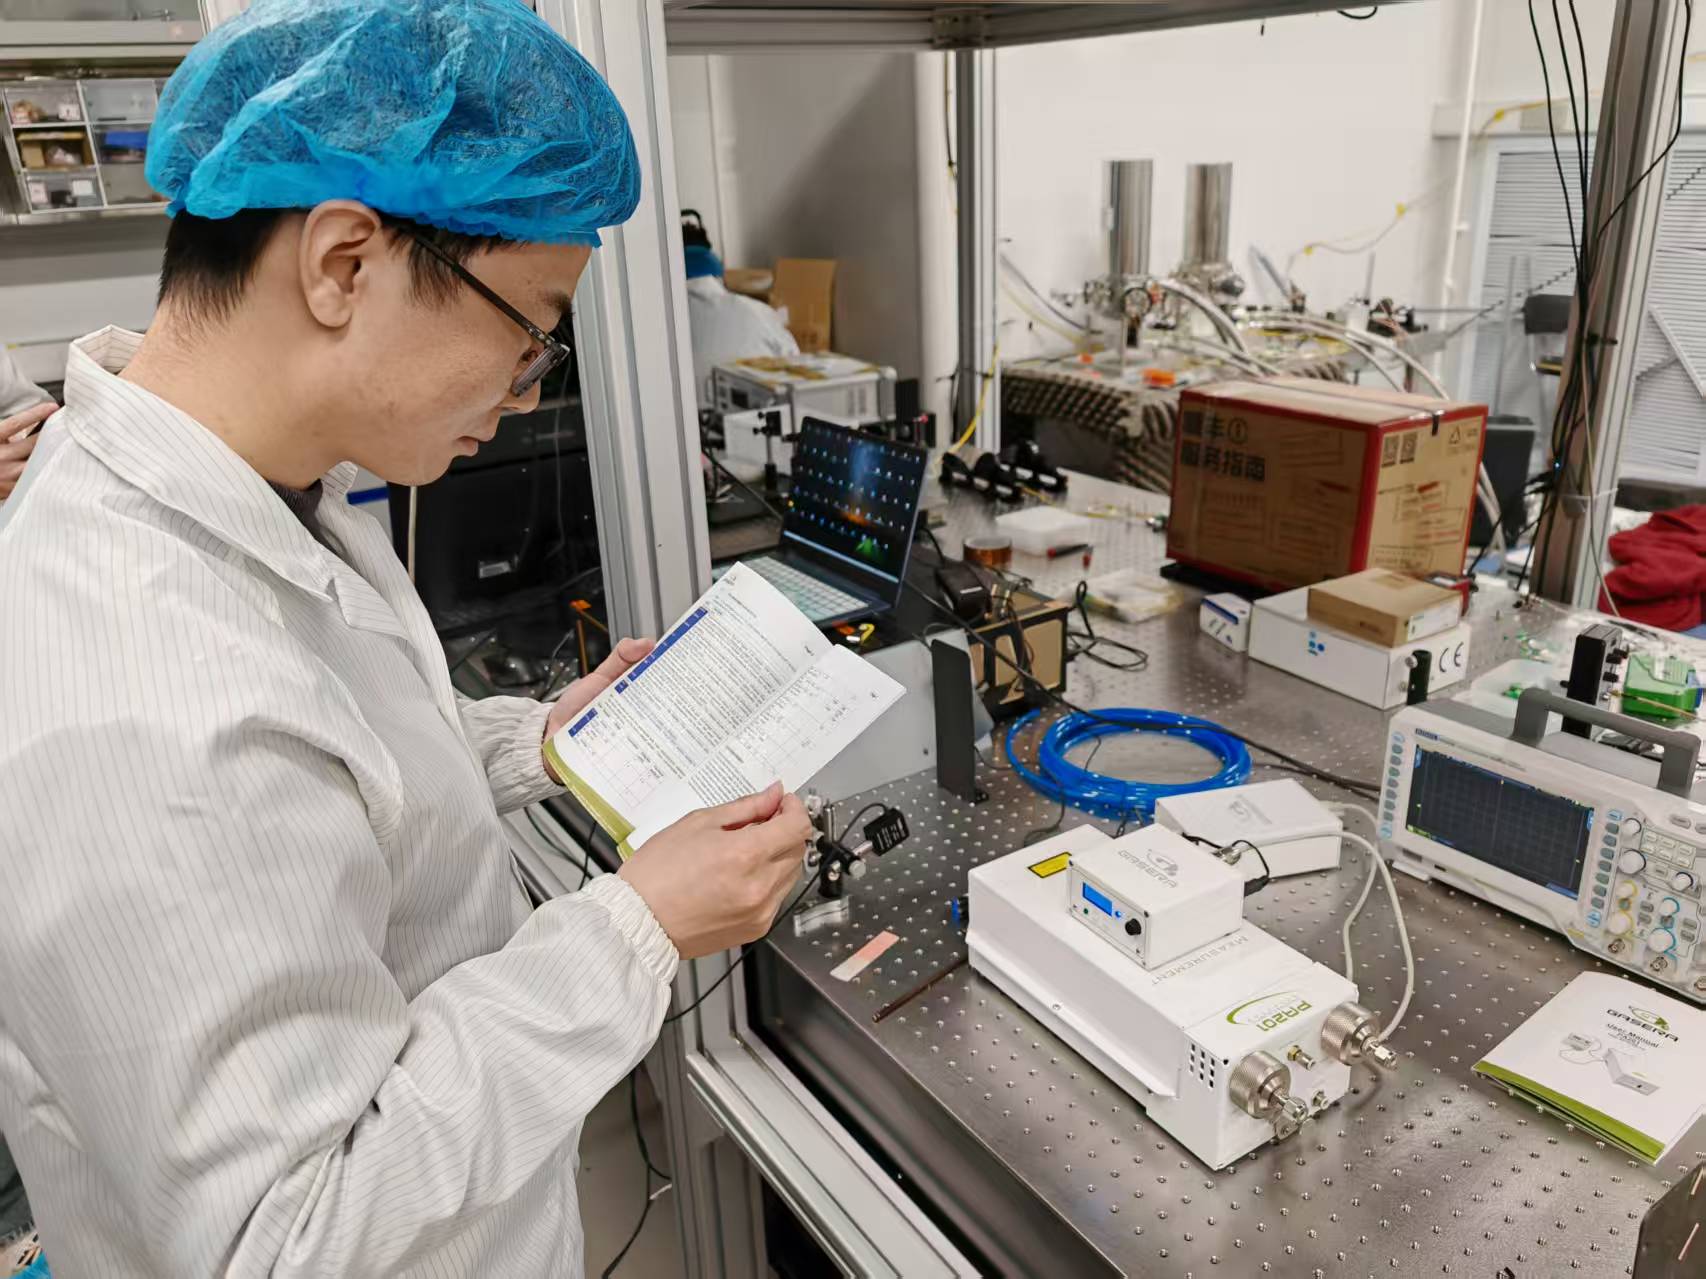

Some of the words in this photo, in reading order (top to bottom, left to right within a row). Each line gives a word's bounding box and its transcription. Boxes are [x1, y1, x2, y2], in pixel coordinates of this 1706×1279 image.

[1118, 850, 1178, 888] GASERA
[1152, 935, 1249, 985] MEASUREMENT
[1256, 1000, 1312, 1031] PA201
[1606, 1009, 1679, 1042] GASERA
